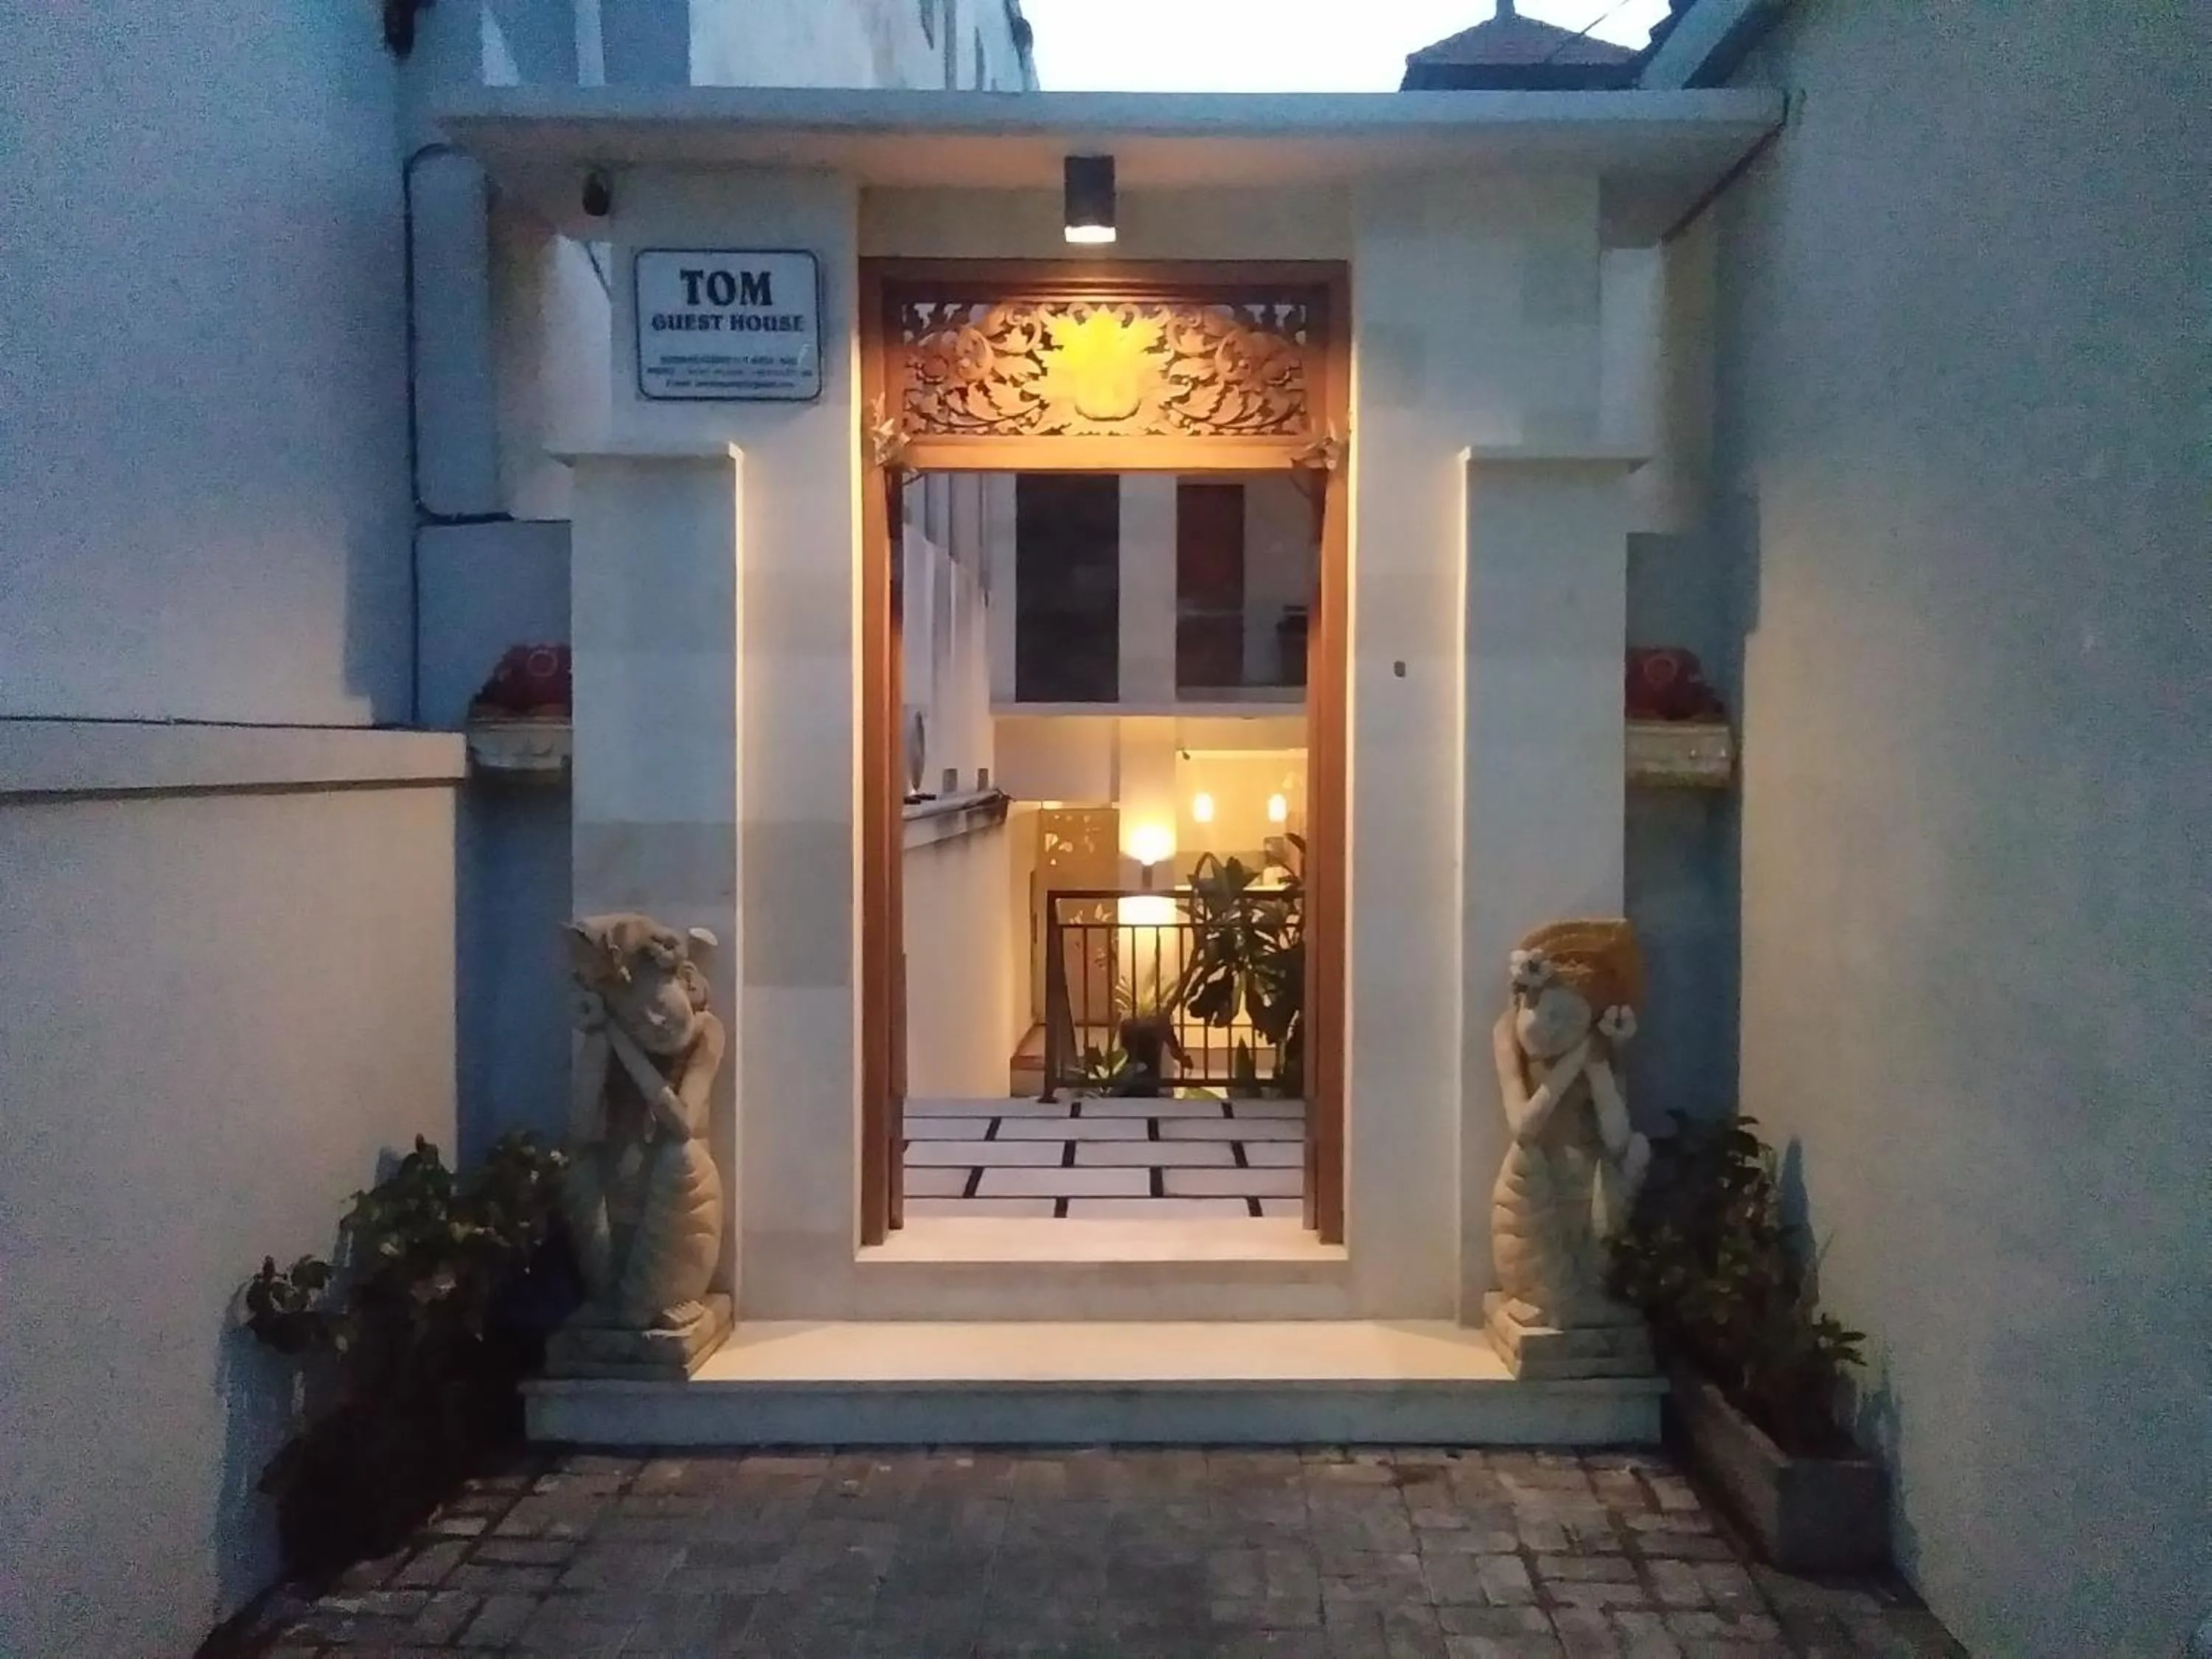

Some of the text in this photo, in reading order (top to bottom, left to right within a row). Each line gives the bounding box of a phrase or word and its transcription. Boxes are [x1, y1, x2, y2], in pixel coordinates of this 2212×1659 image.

[679, 269, 773, 306] TOM
[651, 313, 805, 332] GUEST HOUSE
